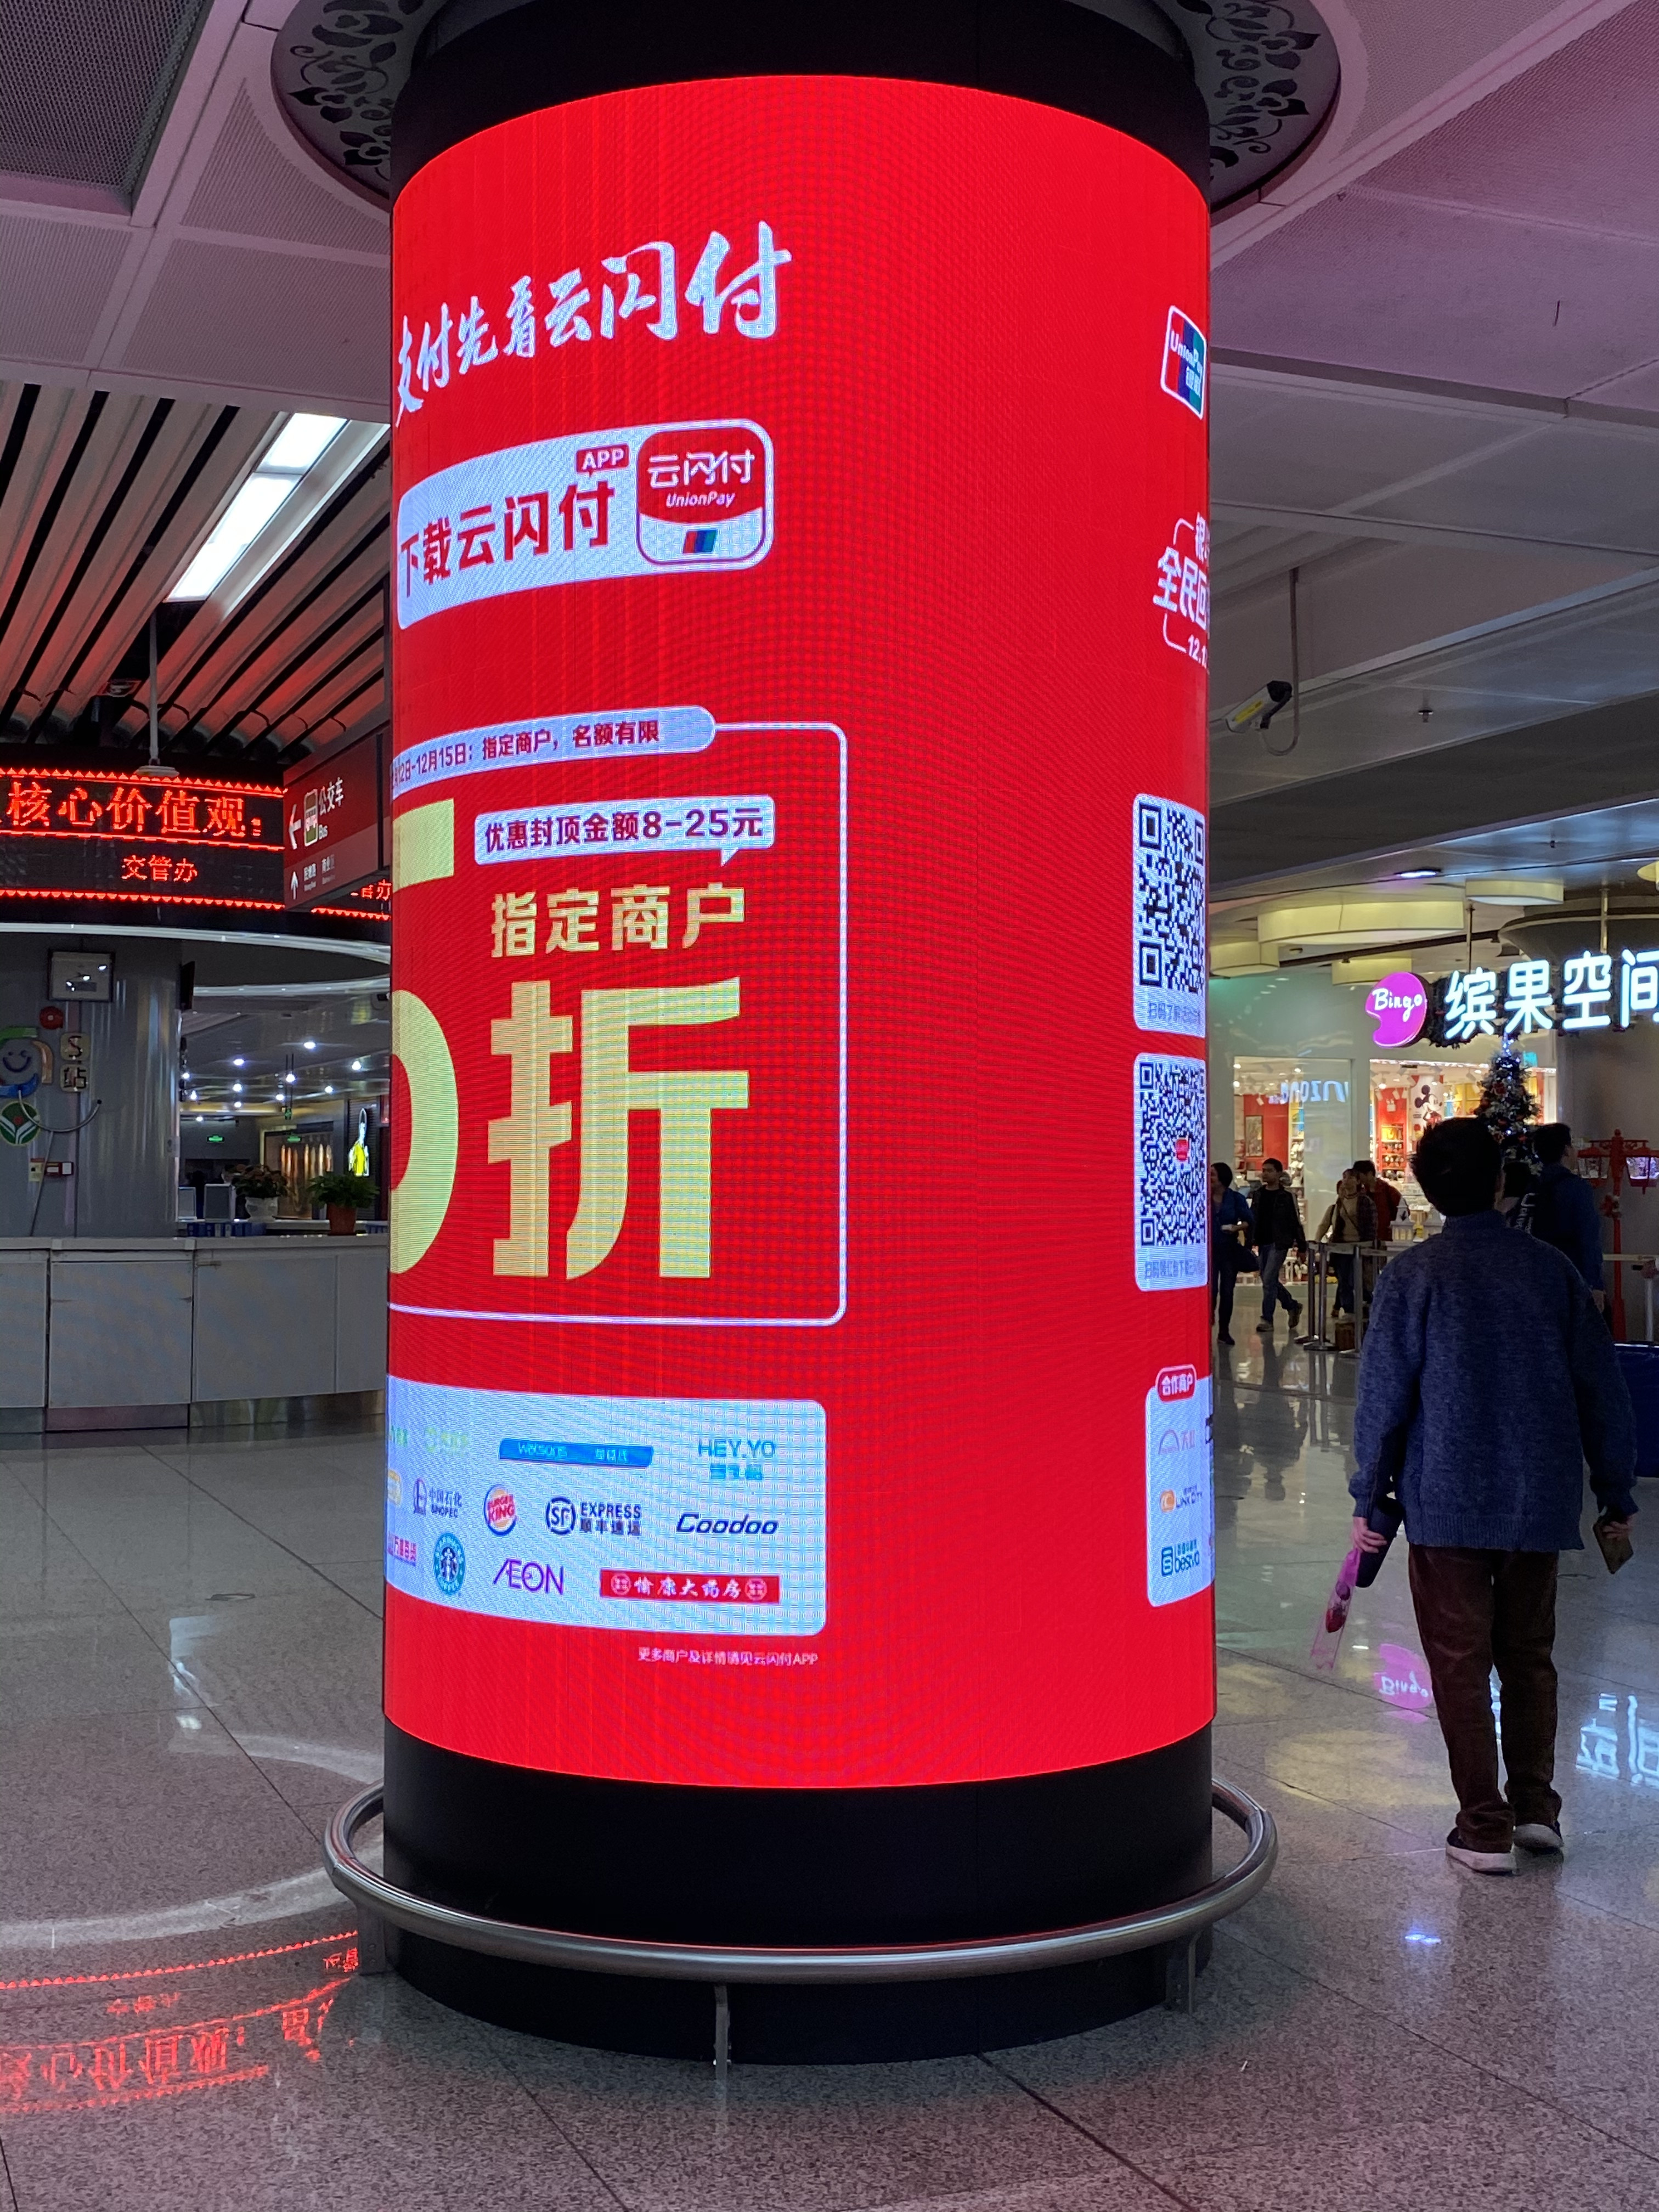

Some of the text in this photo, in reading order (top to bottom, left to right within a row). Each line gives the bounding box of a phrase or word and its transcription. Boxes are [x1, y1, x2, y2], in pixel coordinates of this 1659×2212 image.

[581, 447, 625, 470] APP
[648, 449, 755, 488] 云闪付
[665, 491, 736, 509] UnionPay
[400, 481, 616, 598] 下载云闪付
[319, 777, 343, 816] 公交车
[485, 808, 764, 853] 优惠封顶金额8-25元
[121, 854, 198, 882] 交管办
[490, 881, 746, 958] 指定商户
[1372, 988, 1423, 1022] Bingo
[580, 1501, 642, 1519] EXPRESS
[676, 1511, 778, 1534] Coodoo
